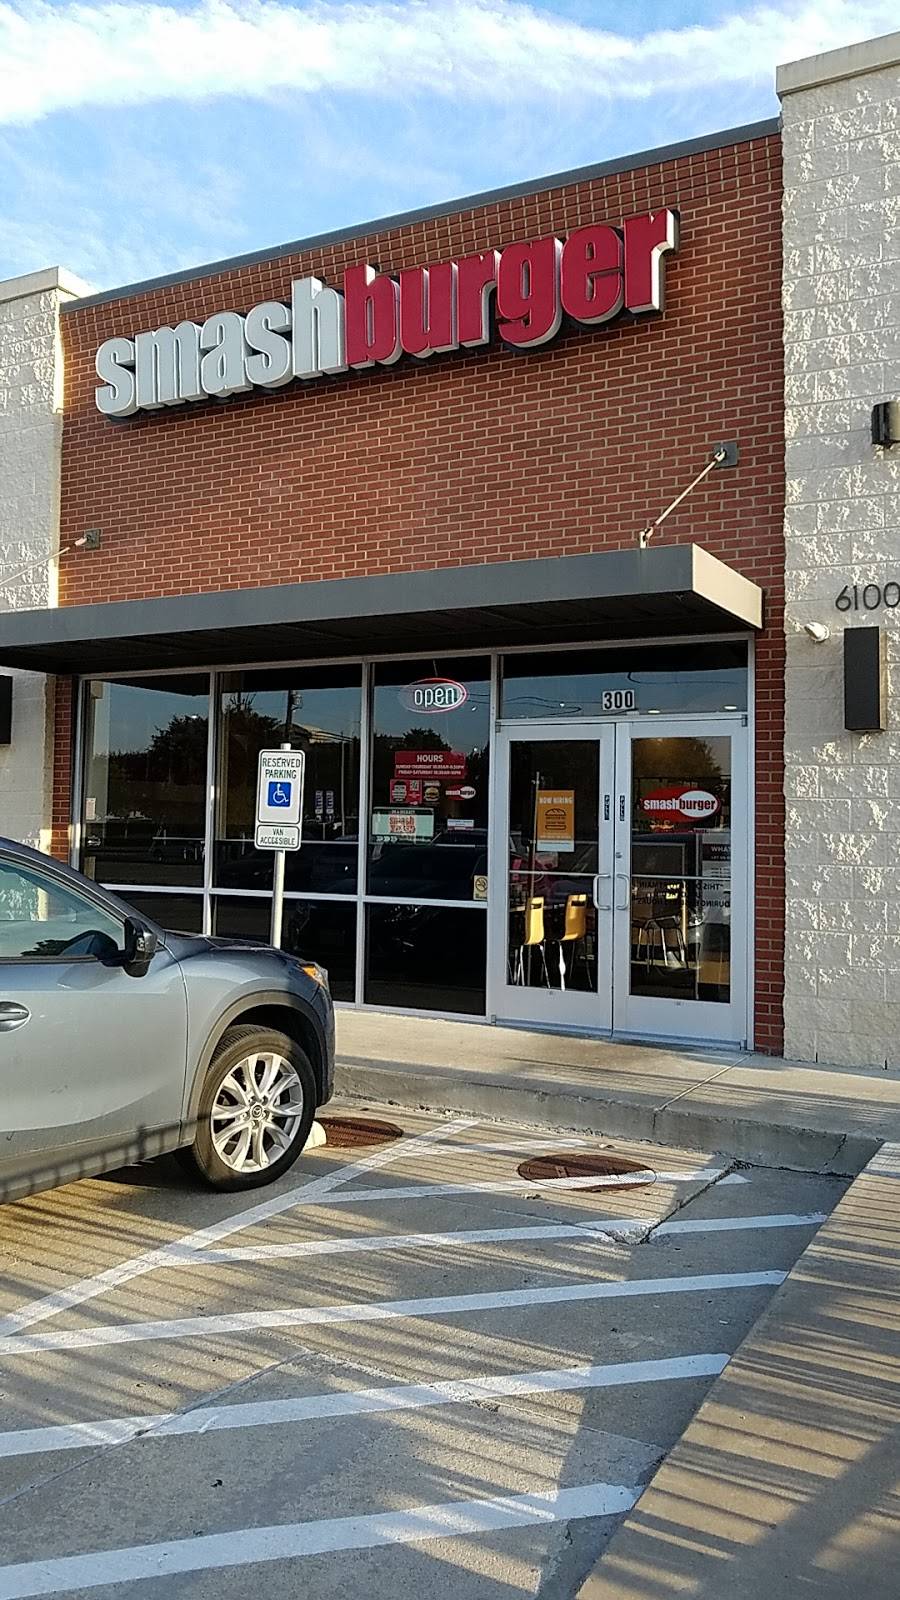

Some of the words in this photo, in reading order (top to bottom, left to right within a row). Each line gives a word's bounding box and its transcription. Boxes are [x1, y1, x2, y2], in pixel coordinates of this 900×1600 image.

[94, 208, 677, 417] smashburger
[835, 582, 900, 612] 6100
[414, 687, 456, 707] open
[603, 691, 634, 710] 300
[262, 757, 301, 768] RESERVED
[416, 754, 444, 763] HOURS
[264, 769, 297, 779] PARKING
[643, 798, 716, 811] smashburger
[272, 828, 284, 836] VAN
[260, 836, 295, 845] ACCESSIBLE
